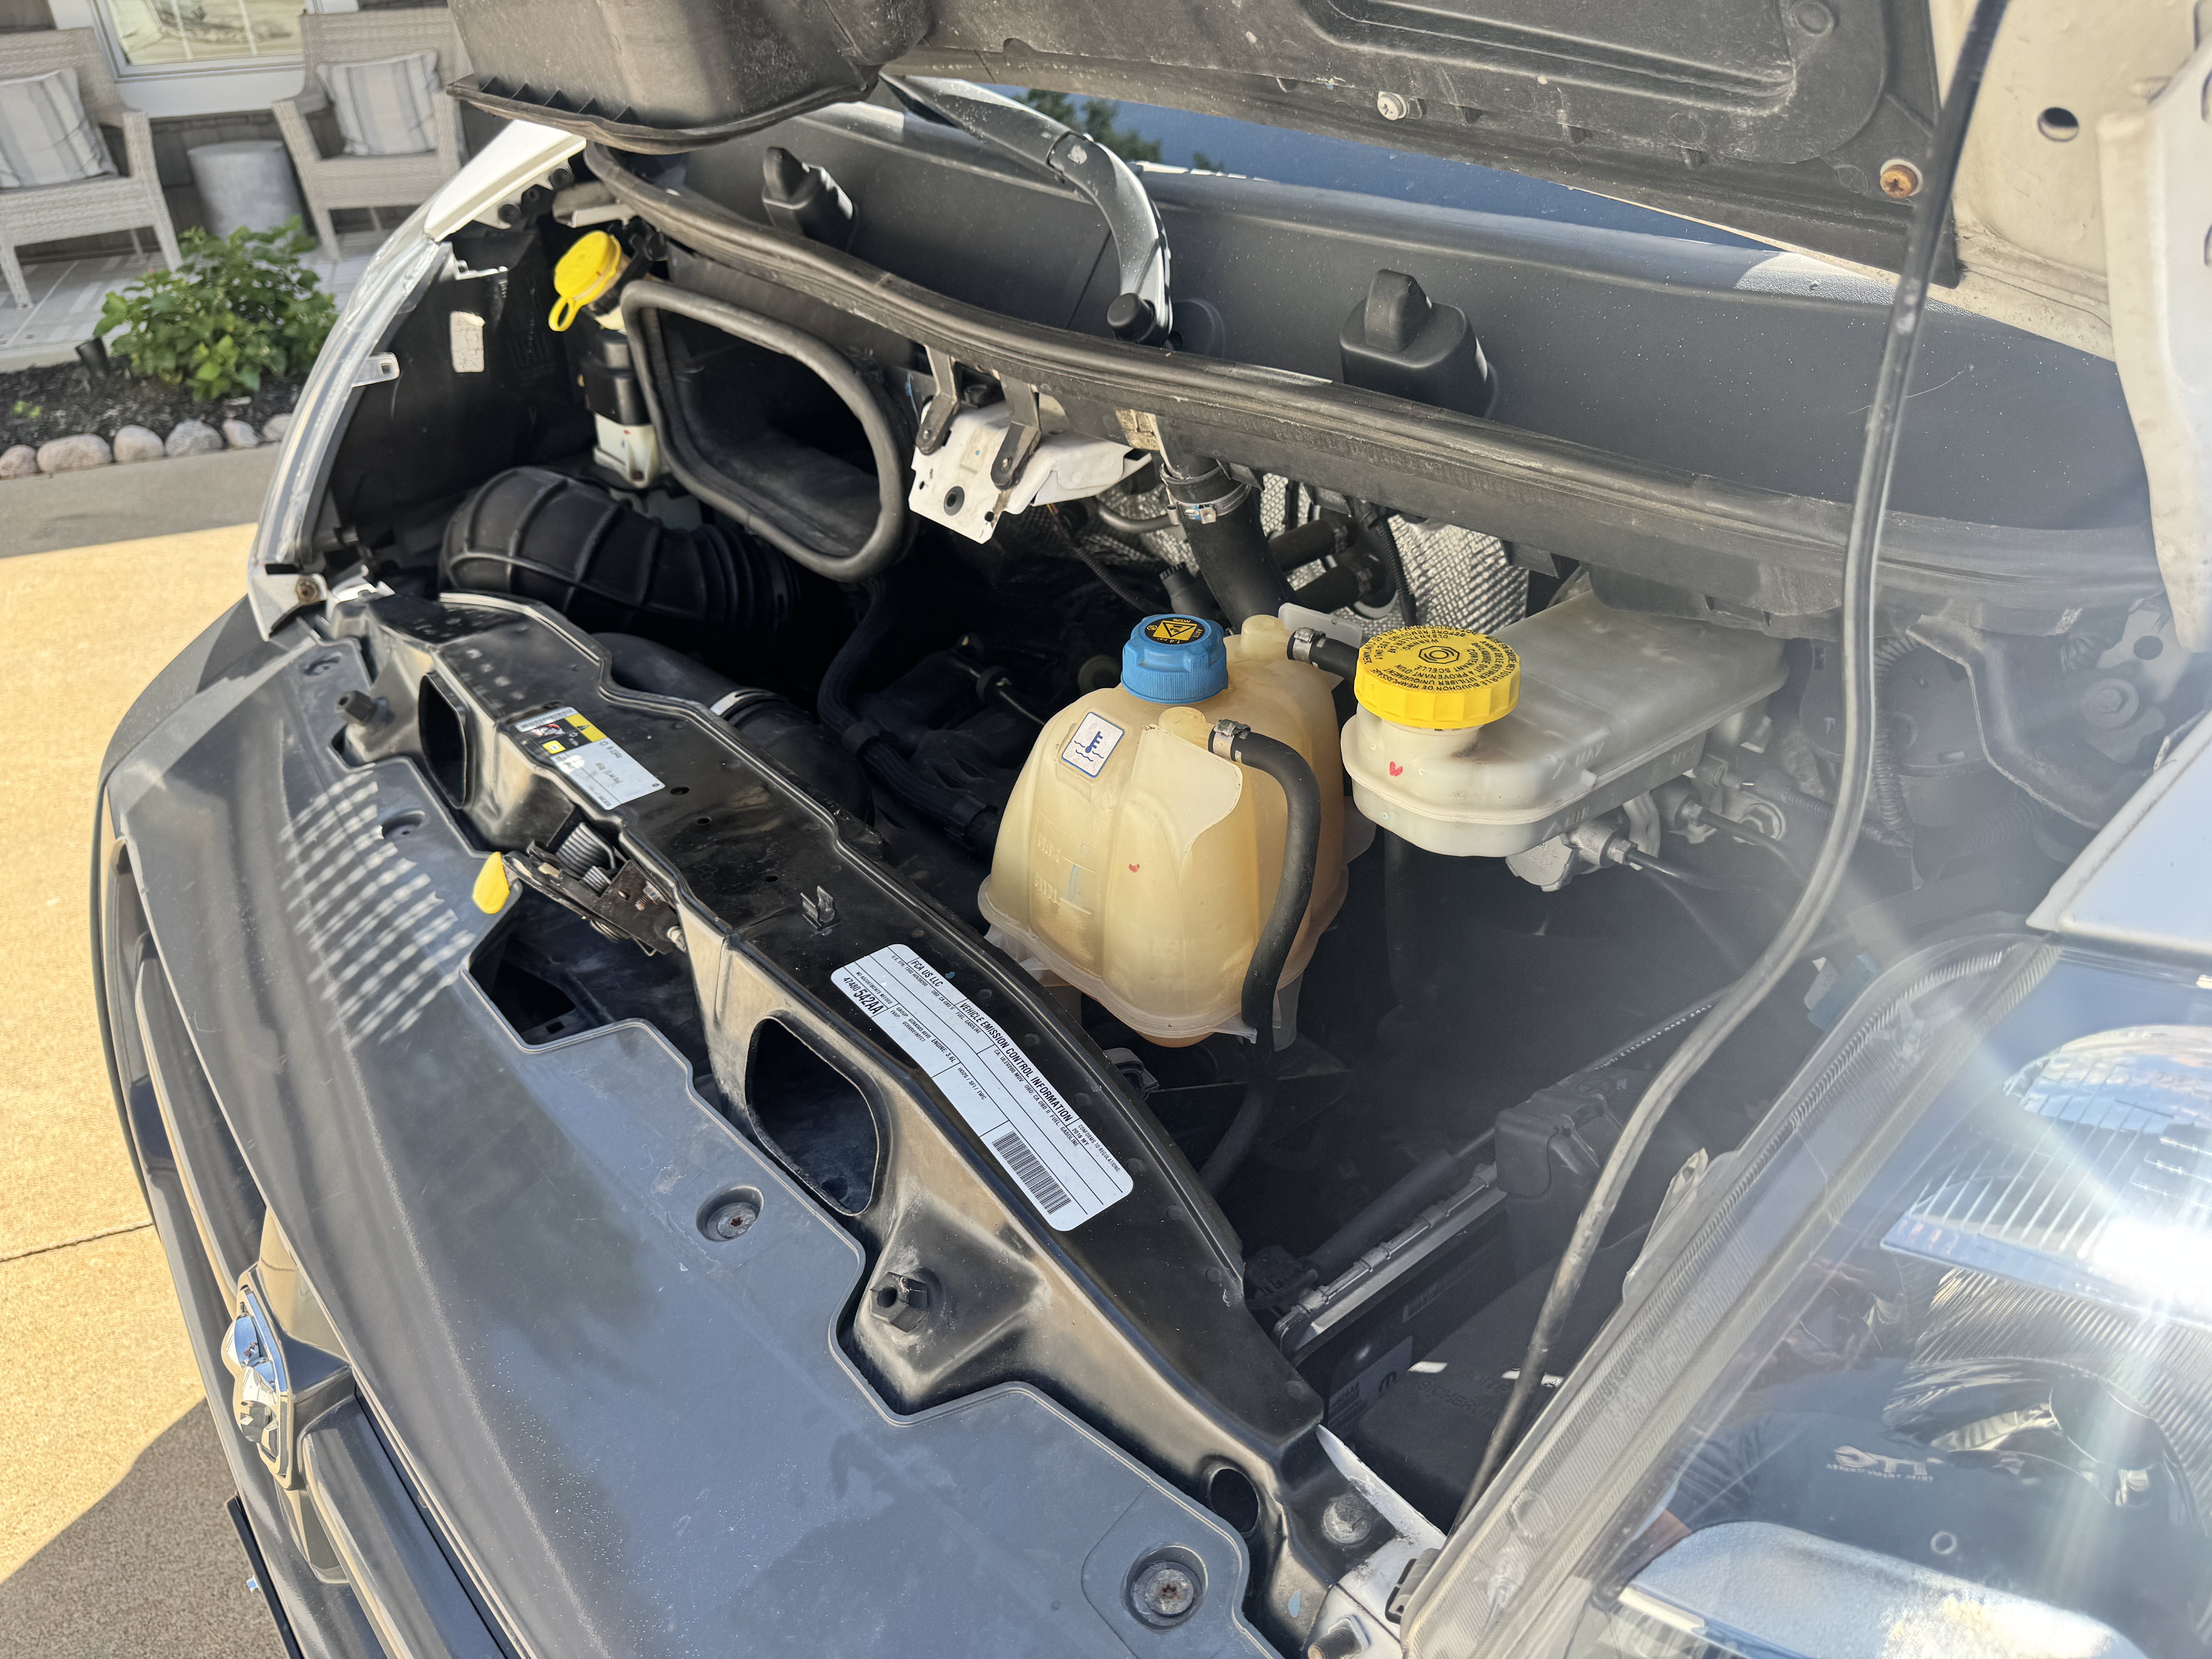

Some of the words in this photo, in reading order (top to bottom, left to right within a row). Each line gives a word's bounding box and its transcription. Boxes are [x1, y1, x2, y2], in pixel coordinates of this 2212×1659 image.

[1382, 668, 1434, 685] UNIQUEMENT
[1437, 677, 1477, 685] UTILISER
[910, 960, 925, 971] FCA
[921, 969, 934, 978] US
[929, 976, 944, 987] LLC
[931, 1039, 947, 1054] ENGINE:
[945, 1052, 956, 1063] 3.6L
[959, 1002, 985, 1023] VEHICLE
[980, 1021, 1010, 1049] EMISSION
[1005, 1048, 1034, 1078] CONTROL
[1030, 1076, 1073, 1122] INFORMATION
[969, 1080, 977, 1088] SFI
[976, 1090, 987, 1100] TWC
[1013, 1072, 1025, 1082] MDV
[1049, 1114, 1061, 1127] FUEL:
[1060, 1126, 1080, 1147] GASOLINE
[1072, 1128, 1083, 1139] 2016
[1080, 1138, 1090, 1146] MY
[1078, 1124, 1096, 1144] CONFORMS
[1097, 1147, 1121, 1173] REGULATIONS:
